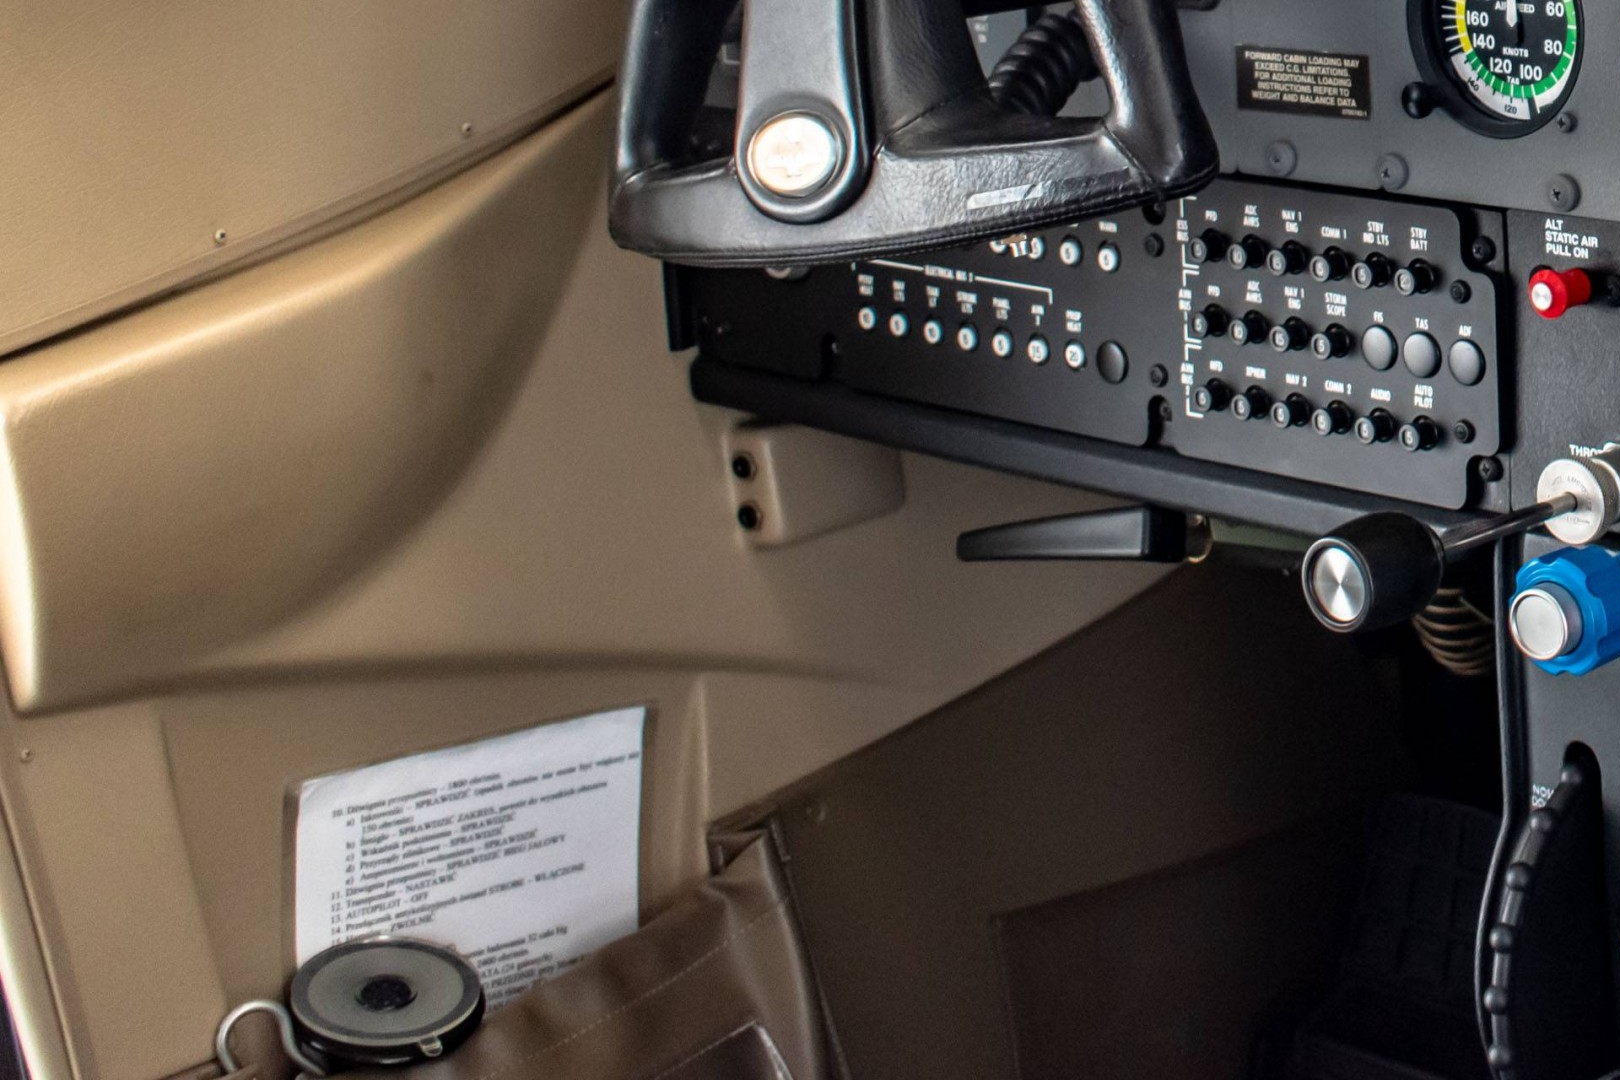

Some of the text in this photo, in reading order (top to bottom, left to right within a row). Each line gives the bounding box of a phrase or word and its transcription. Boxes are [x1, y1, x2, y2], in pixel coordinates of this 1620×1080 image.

[1546, 1, 1564, 18] 60
[1466, 10, 1489, 27] 160
[1502, 46, 1529, 58] KNOTS
[1283, 53, 1342, 67] CABIN LOADING
[1490, 57, 1512, 74] 120
[1520, 64, 1543, 81] 100
[1300, 95, 1357, 107] BALANCE DATA
[1545, 218, 1564, 231] ALT
[1545, 230, 1598, 248] STATIC AIR
[1546, 242, 1589, 259] PULL ON
[1325, 292, 1347, 305] STORM
[1326, 305, 1346, 317] SCOPE
[1415, 317, 1429, 330] TAS
[1414, 383, 1433, 396] AUTO
[1414, 395, 1433, 409] PILOT
